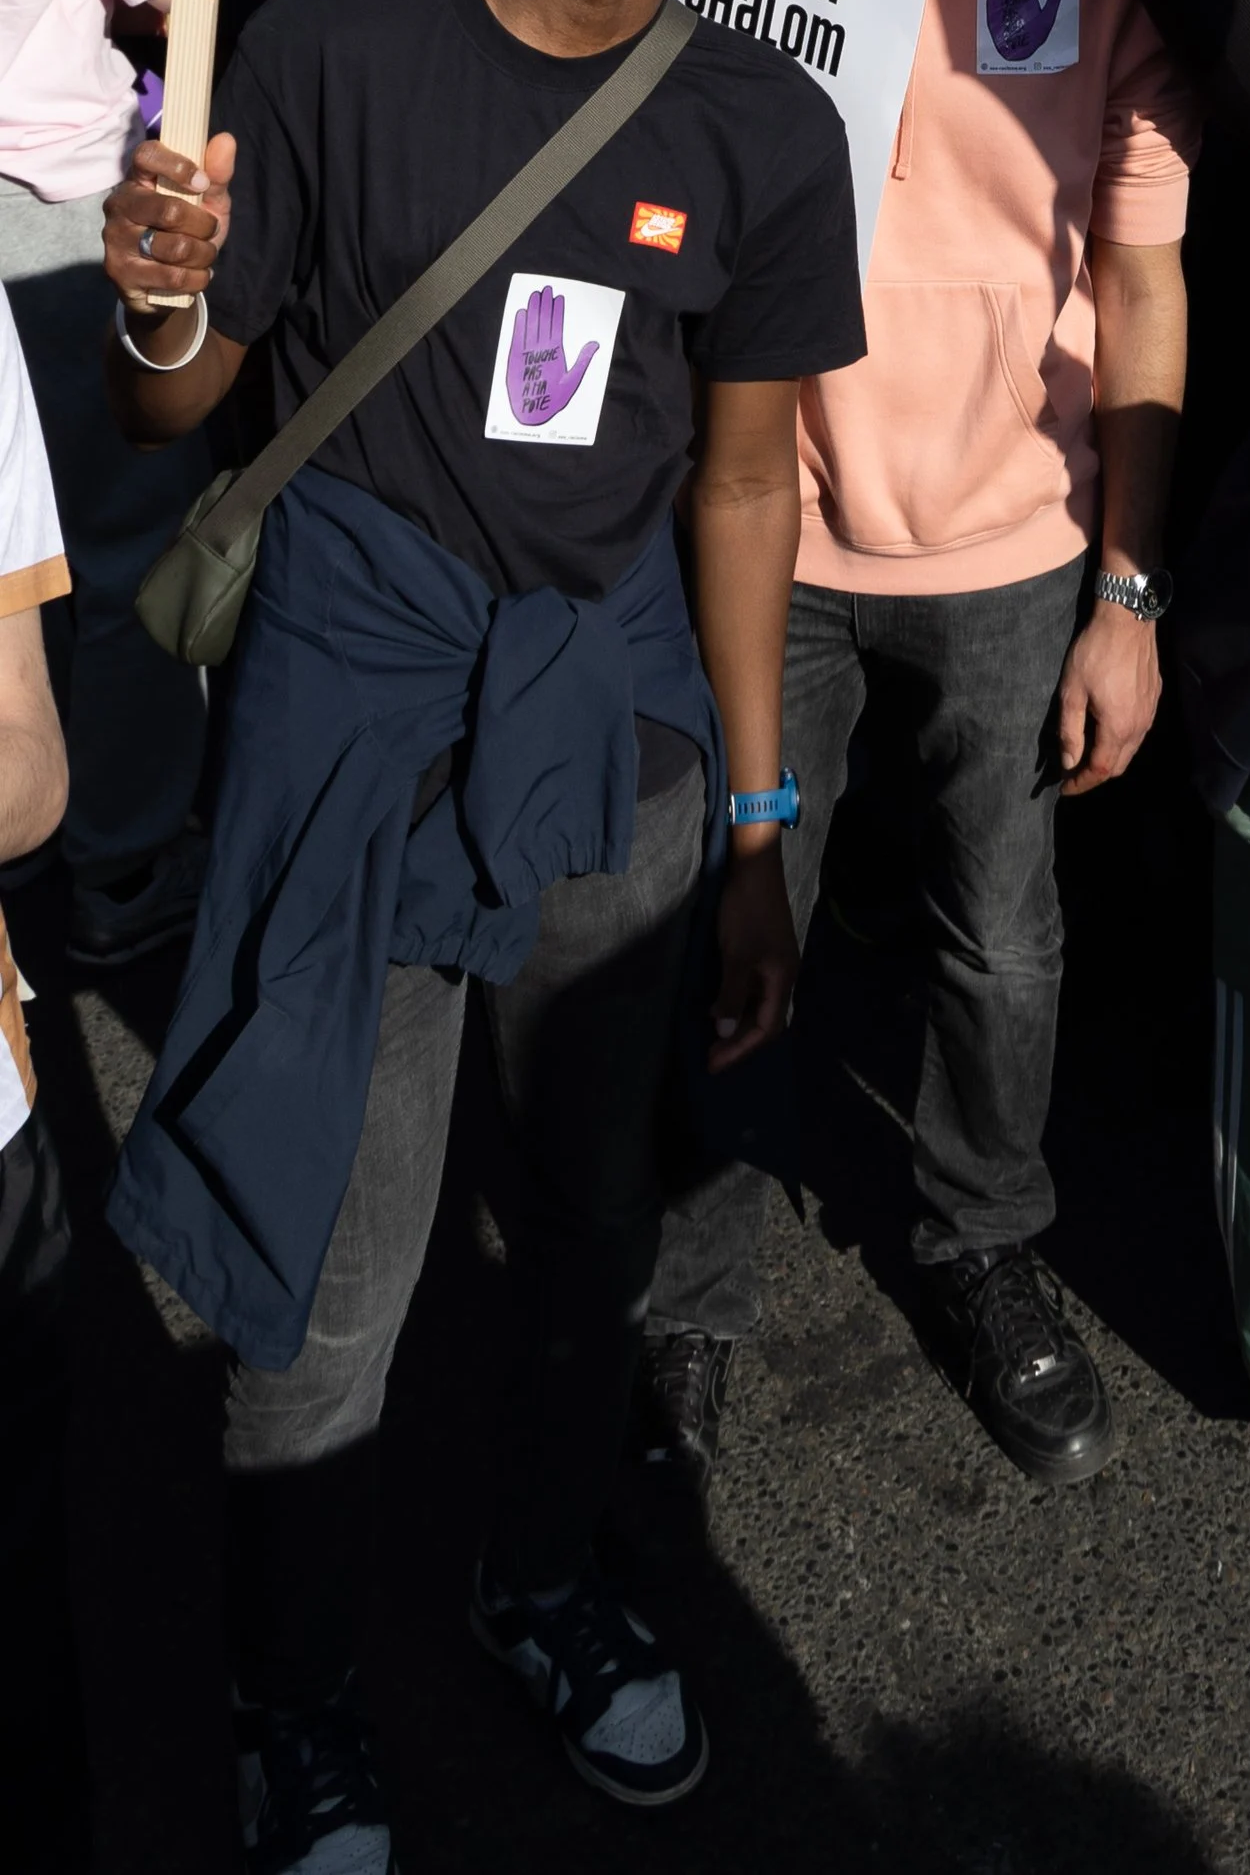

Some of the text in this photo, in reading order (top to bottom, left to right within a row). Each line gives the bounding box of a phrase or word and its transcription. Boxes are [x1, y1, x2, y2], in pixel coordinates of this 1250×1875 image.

[522, 347, 560, 366] TOUCHE
[523, 365, 542, 381] PAS
[522, 381, 546, 397] A MA
[522, 396, 551, 413] POTE
